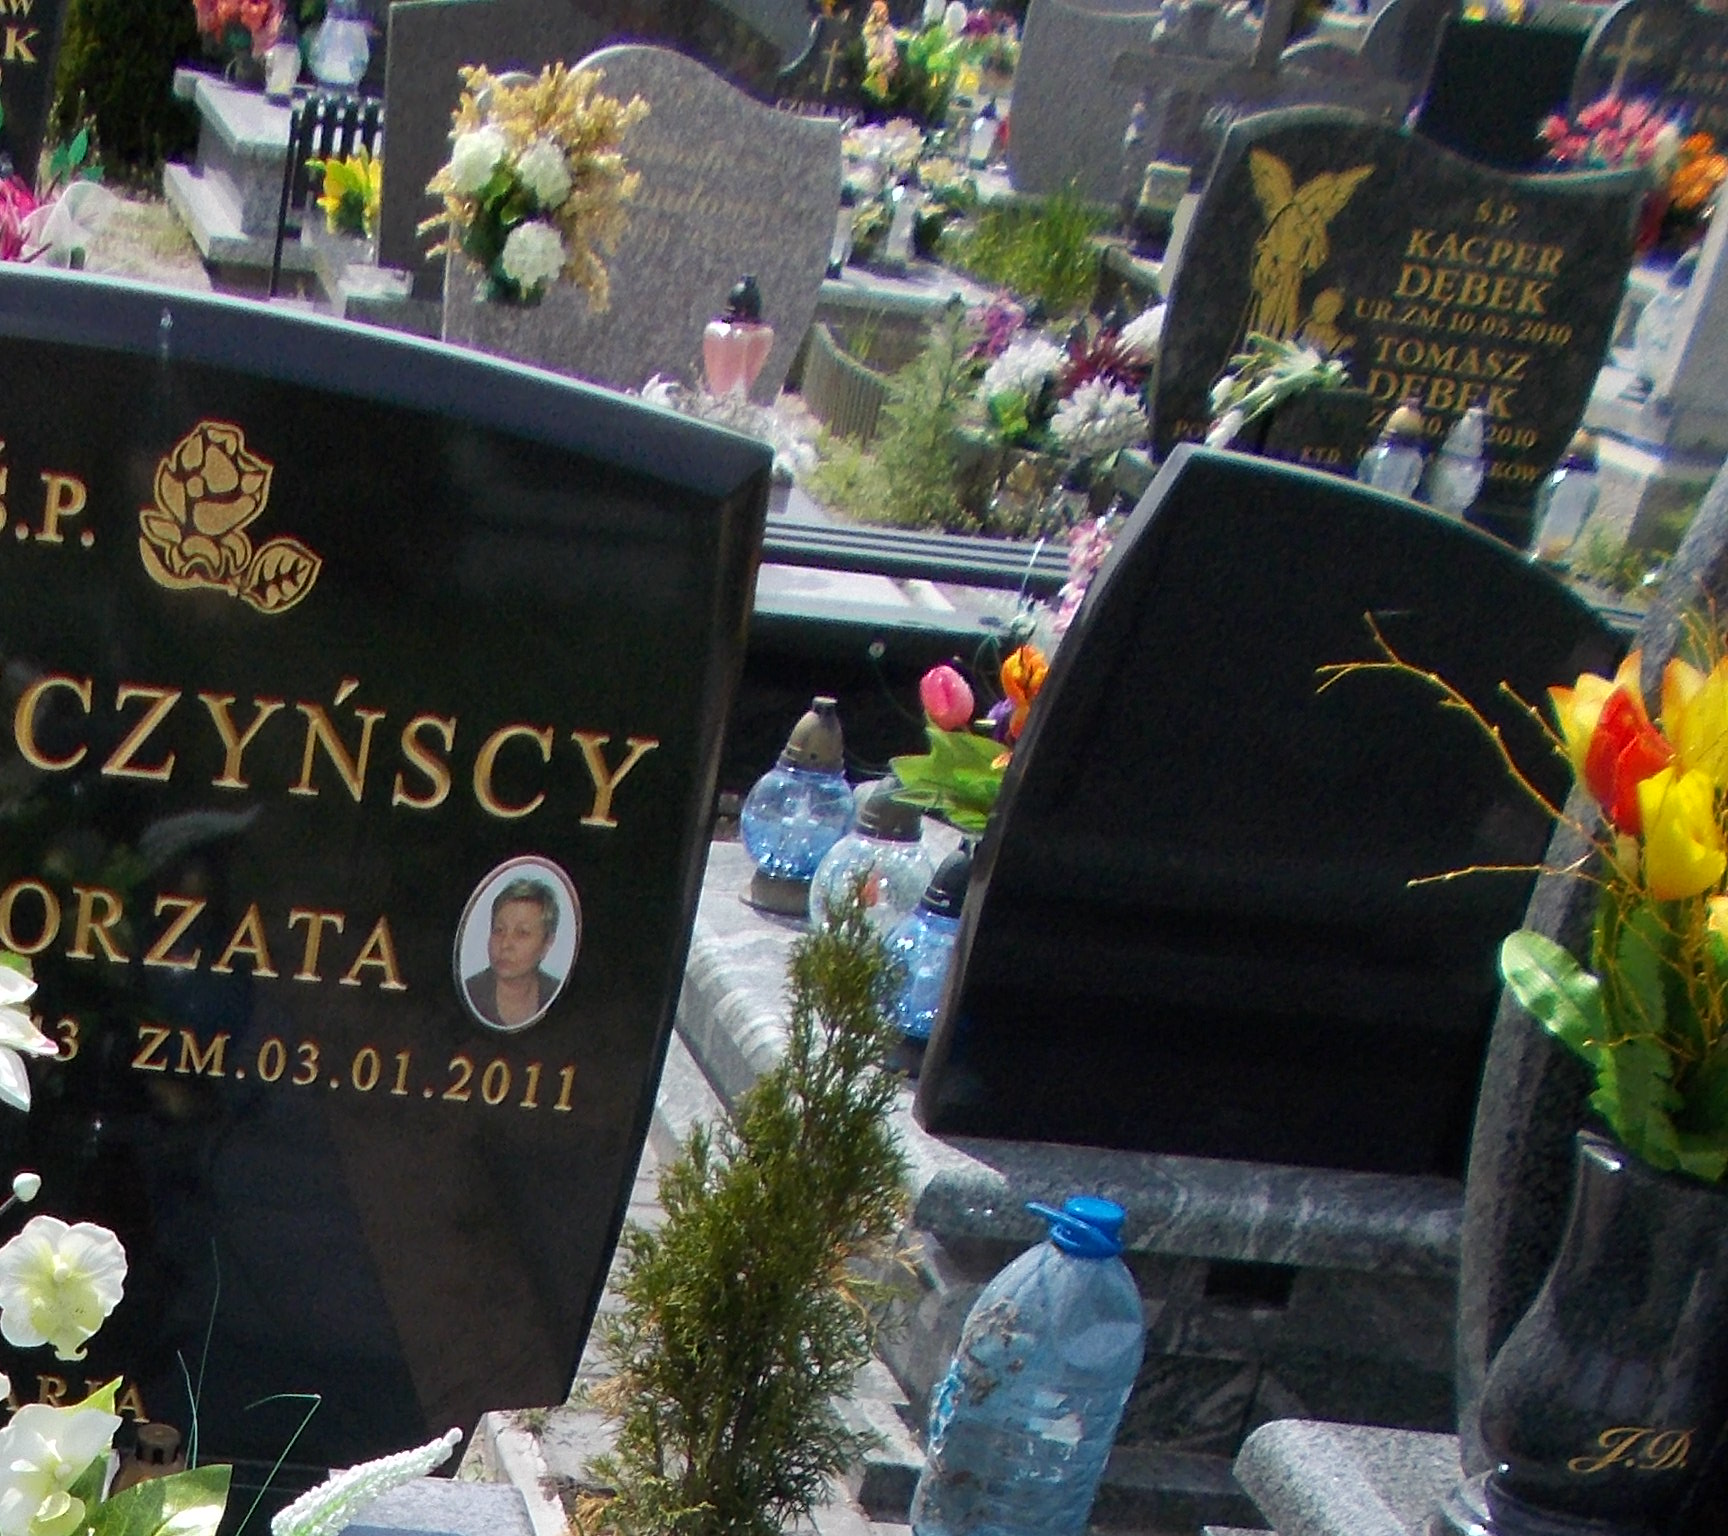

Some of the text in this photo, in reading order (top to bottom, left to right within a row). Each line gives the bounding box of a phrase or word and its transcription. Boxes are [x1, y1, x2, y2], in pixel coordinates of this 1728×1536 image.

[1405, 228, 1565, 277] KACPER
[1374, 334, 1532, 382] TOMASZ
[130, 1020, 578, 1112] ZM.03.01.2011
